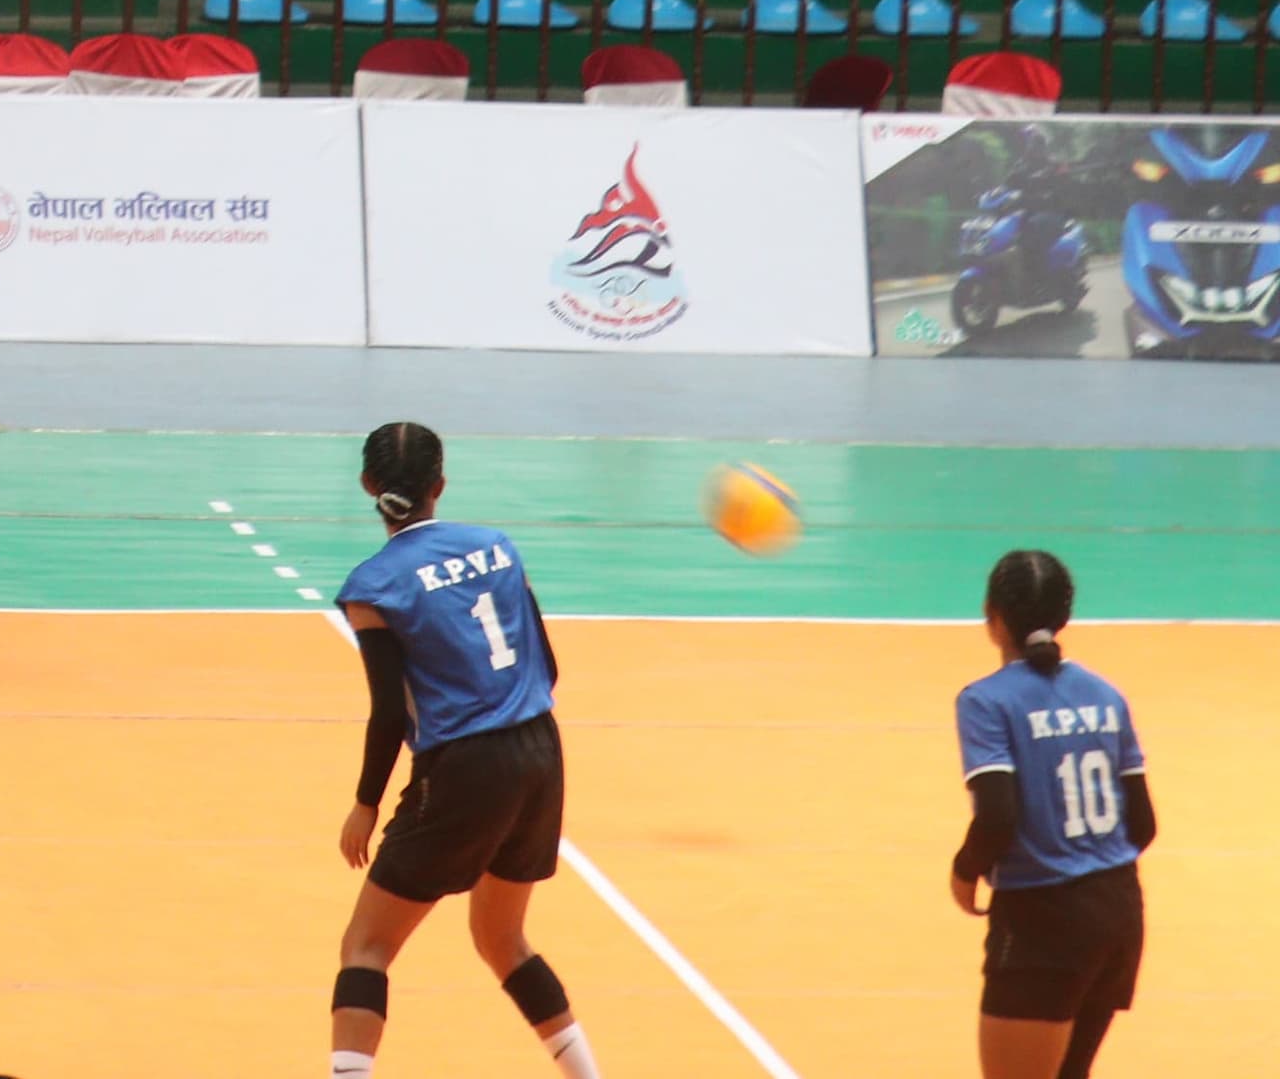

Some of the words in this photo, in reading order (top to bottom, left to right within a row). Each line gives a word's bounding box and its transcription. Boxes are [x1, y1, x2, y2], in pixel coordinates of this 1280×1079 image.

[27, 191, 105, 220] नेपाल
[226, 195, 270, 221] संघ
[29, 226, 79, 246] Nepal
[84, 226, 165, 246] Volleyball
[171, 226, 269, 244] Association
[470, 591, 517, 671] 1
[1056, 749, 1119, 839] 10
